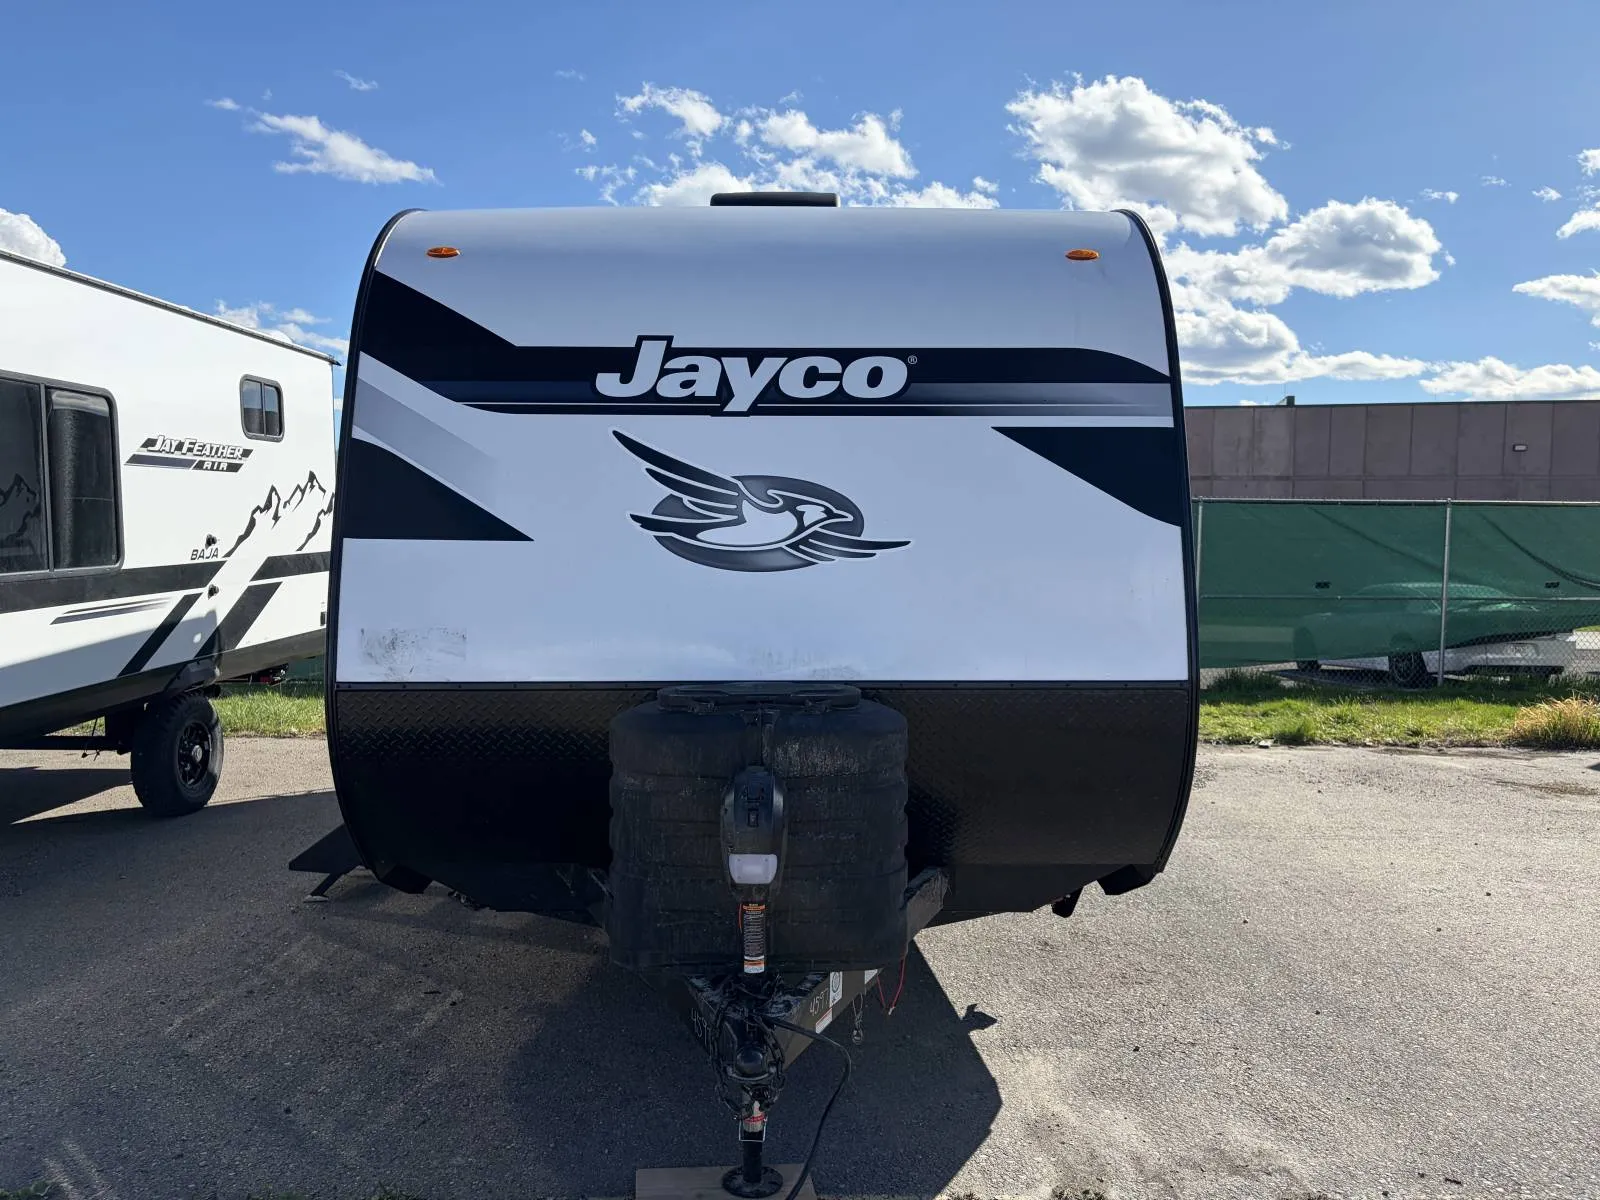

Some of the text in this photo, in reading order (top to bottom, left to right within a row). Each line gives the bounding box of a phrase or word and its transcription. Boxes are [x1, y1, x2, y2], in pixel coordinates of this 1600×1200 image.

[146, 434, 243, 460] JAY FEATHER
[203, 461, 228, 471] AIR
[190, 547, 218, 561] BAJA
